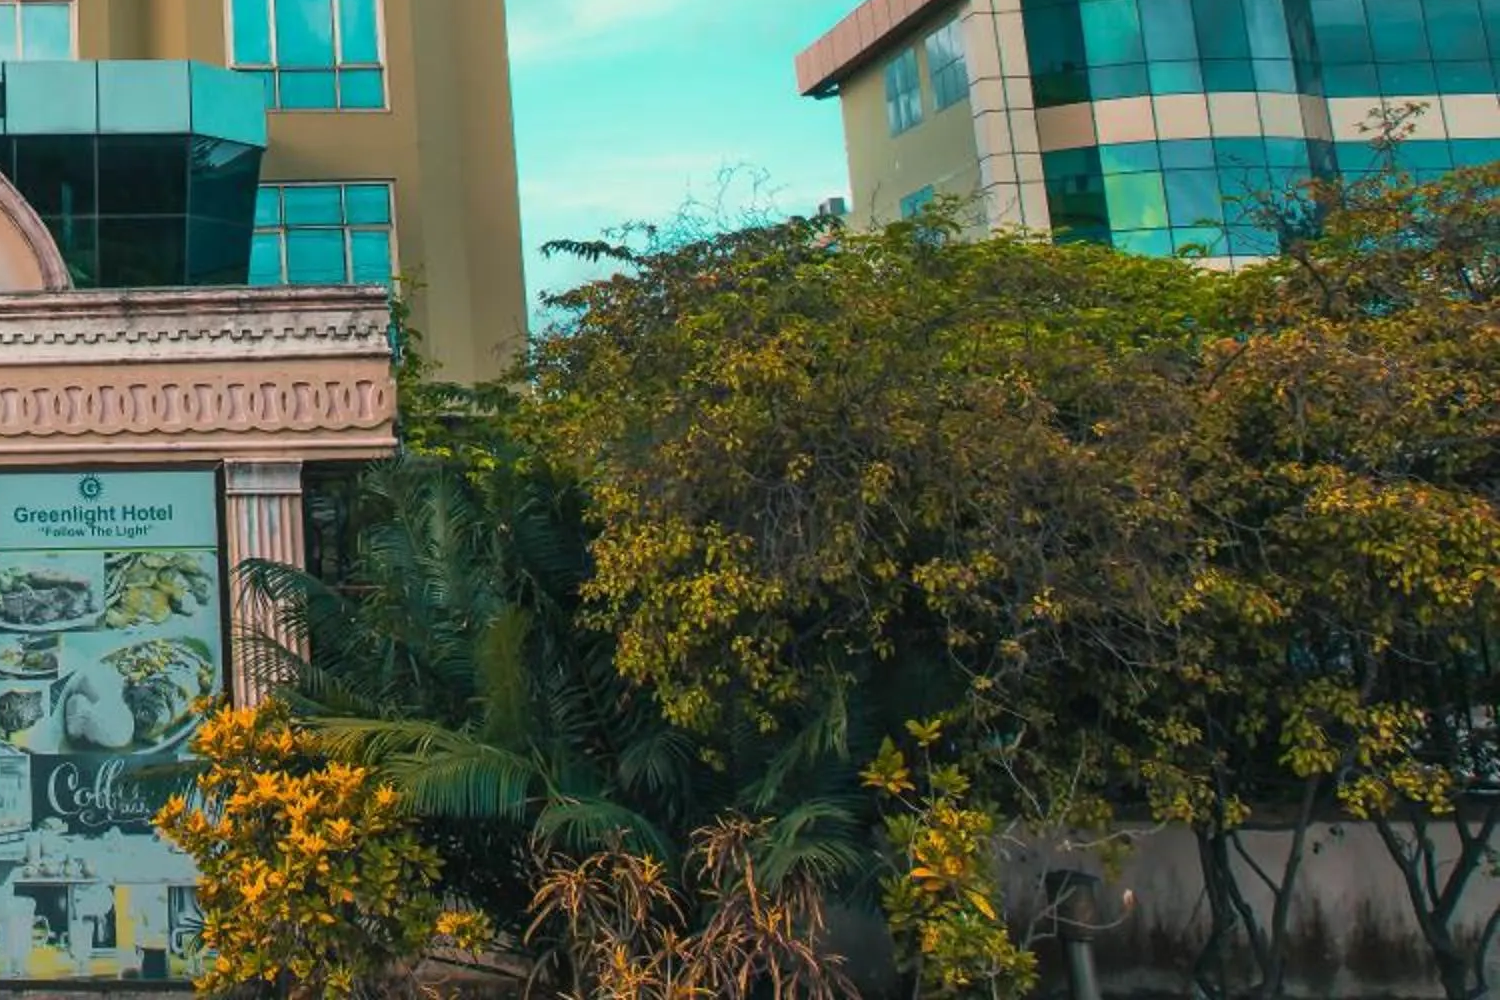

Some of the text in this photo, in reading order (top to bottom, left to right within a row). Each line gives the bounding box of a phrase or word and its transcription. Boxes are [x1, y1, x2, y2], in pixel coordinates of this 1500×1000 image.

[13, 503, 173, 526] Greenlight Hotel
[90, 525, 113, 537] The
